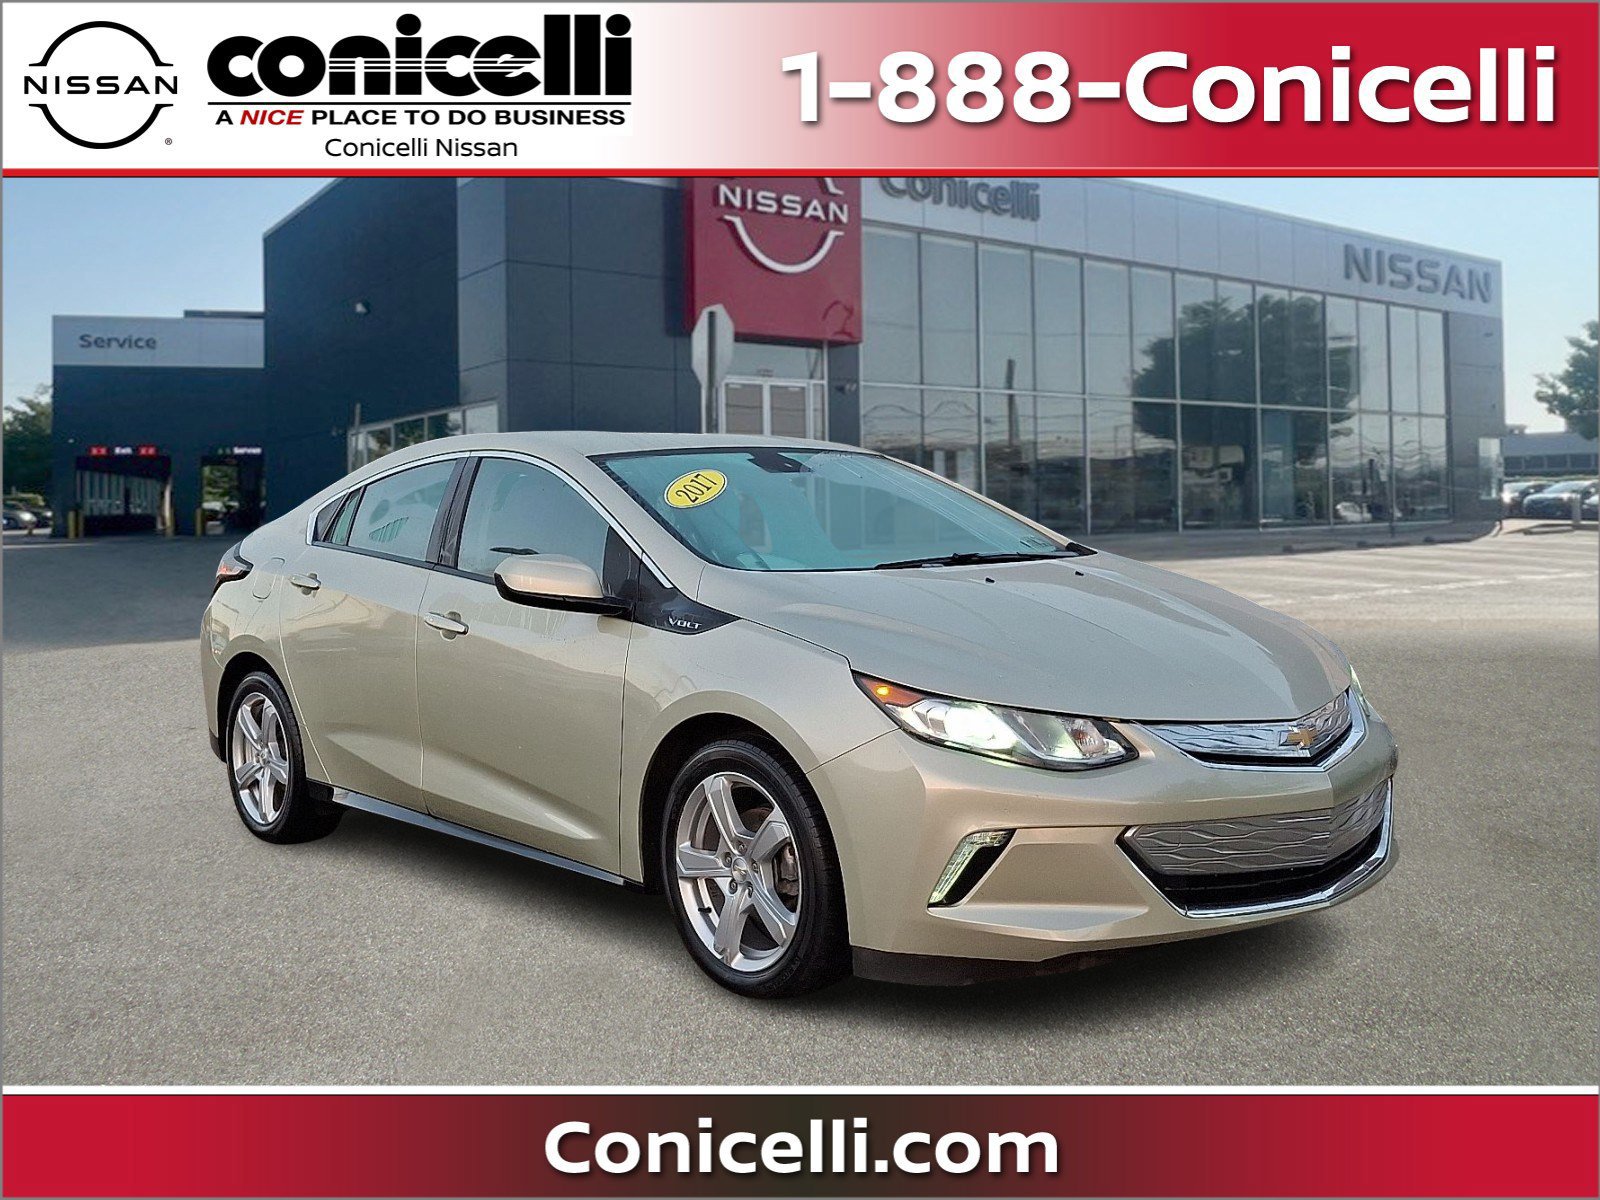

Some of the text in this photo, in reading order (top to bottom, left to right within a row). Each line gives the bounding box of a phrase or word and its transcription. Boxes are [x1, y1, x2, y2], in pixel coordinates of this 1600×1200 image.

[718, 184, 849, 225] NISSAN
[1343, 243, 1494, 303] NISSAN
[79, 333, 157, 350] Service
[675, 473, 717, 503] 2017
[668, 615, 702, 629] VOLT
